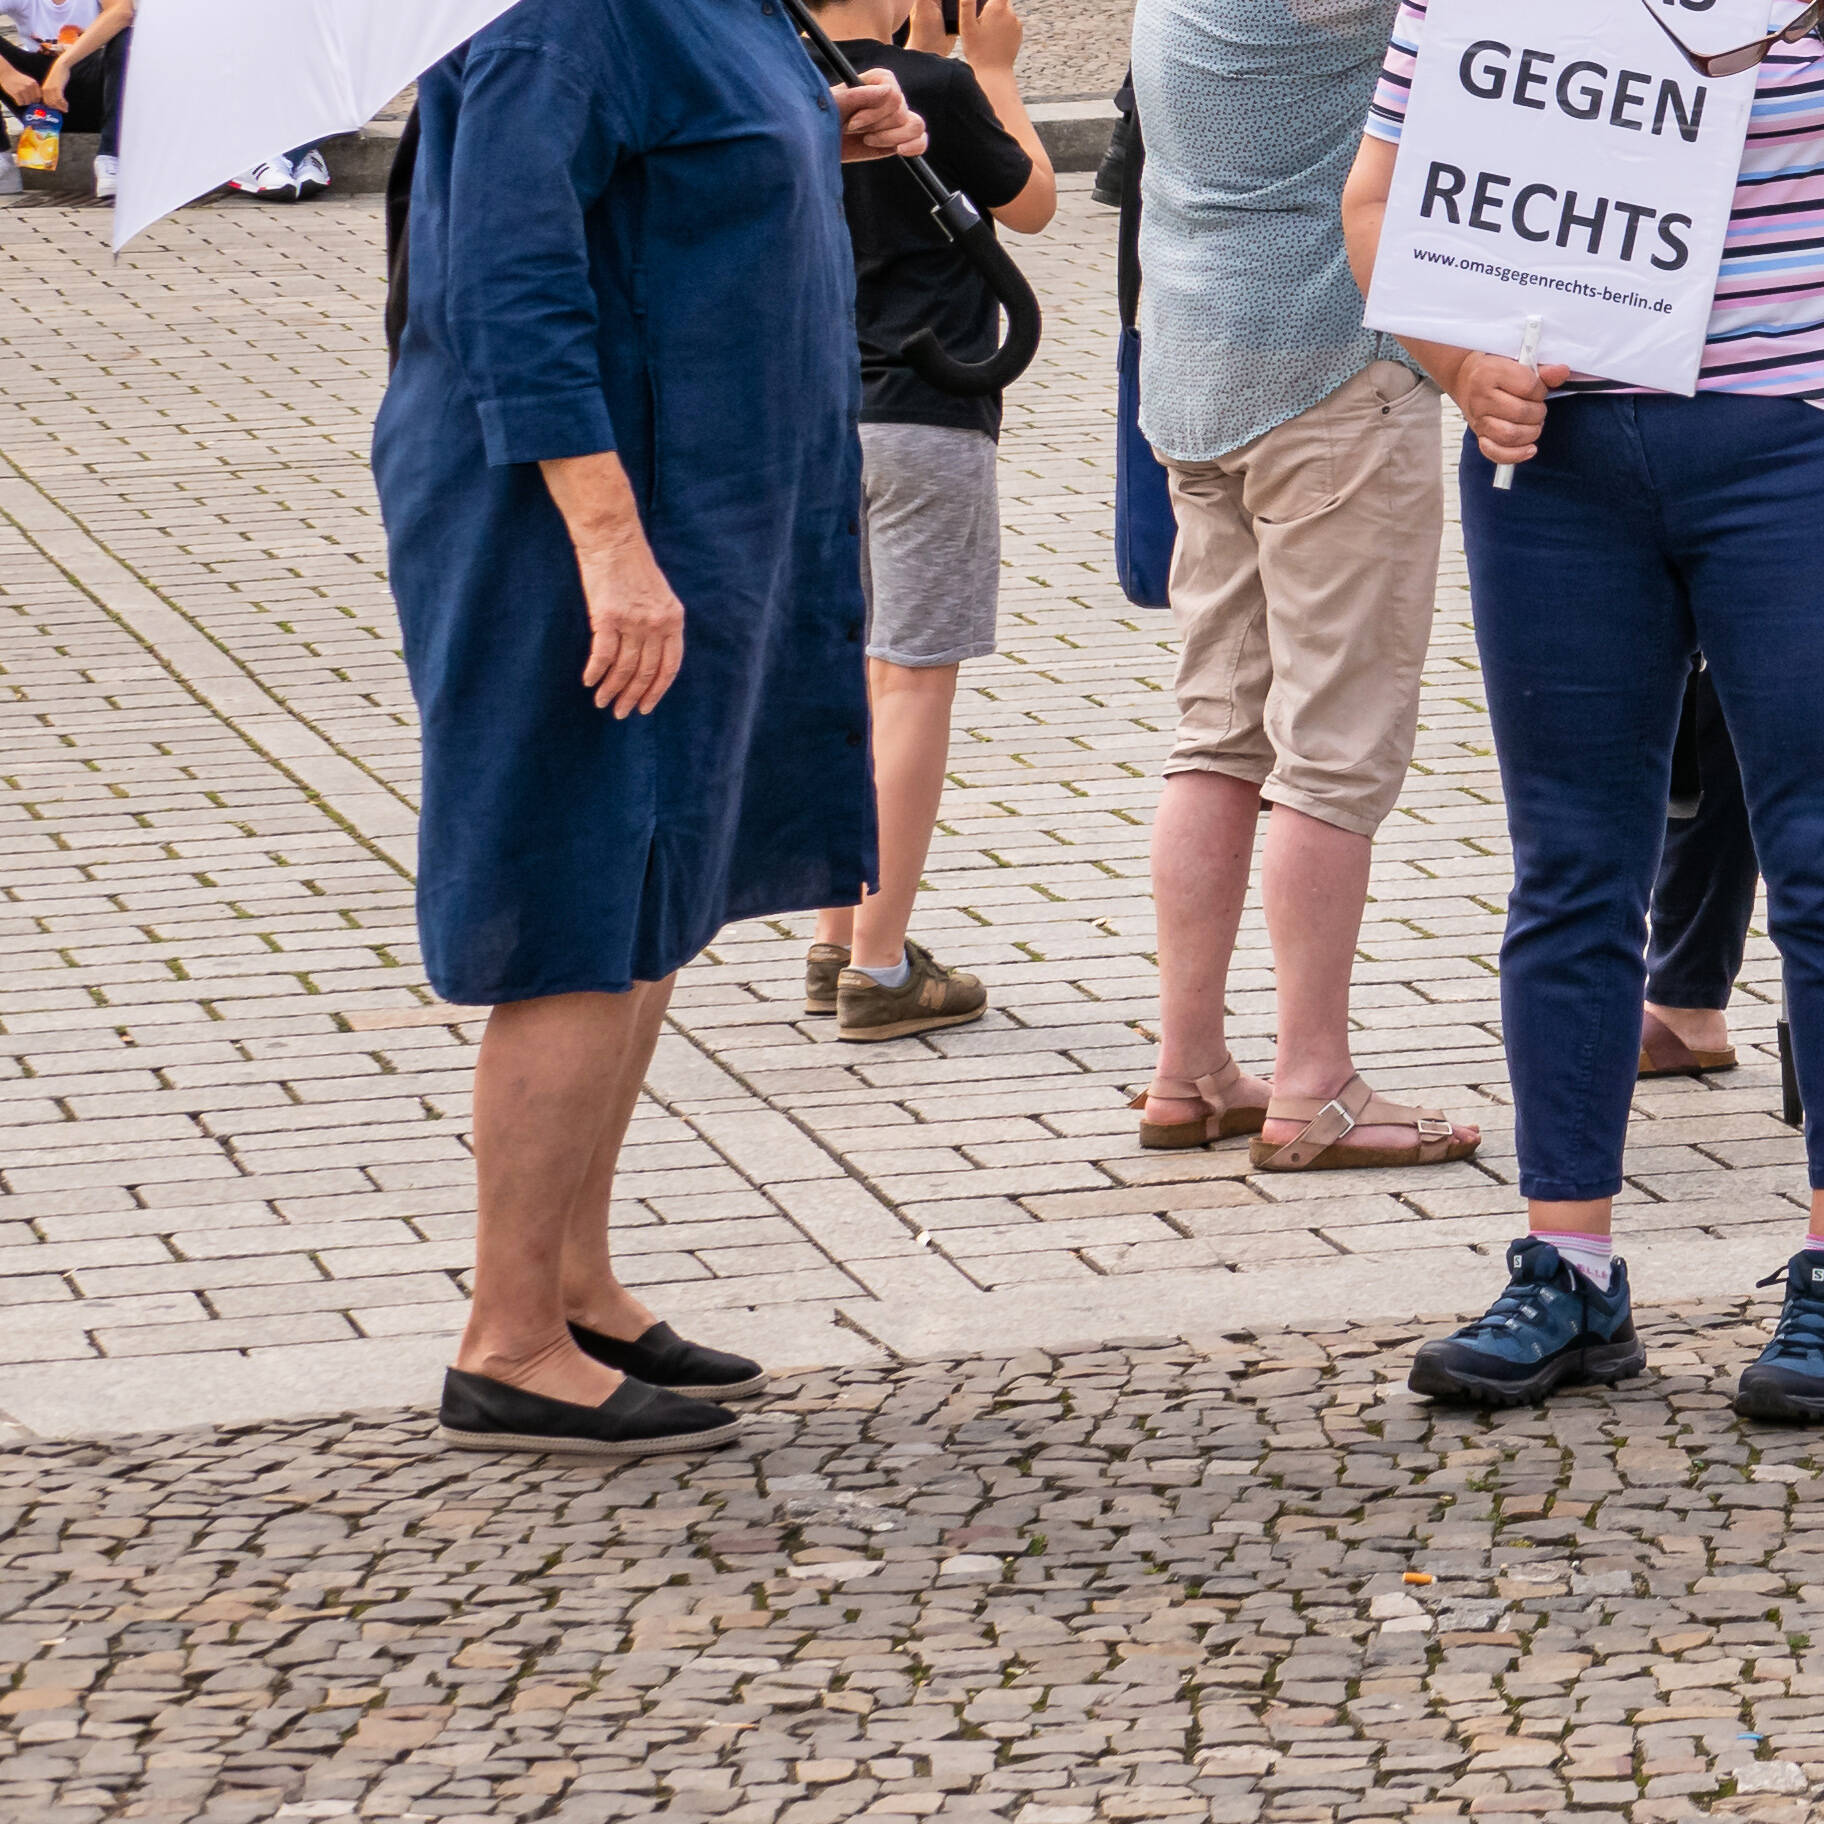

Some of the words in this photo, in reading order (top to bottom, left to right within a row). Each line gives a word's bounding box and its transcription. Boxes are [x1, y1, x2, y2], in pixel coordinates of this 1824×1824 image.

[1459, 40, 1707, 143] GEGEN
[1420, 161, 1692, 272] RECHTS
[1413, 247, 1674, 315] www.omasgegenrechts-berlin.de
